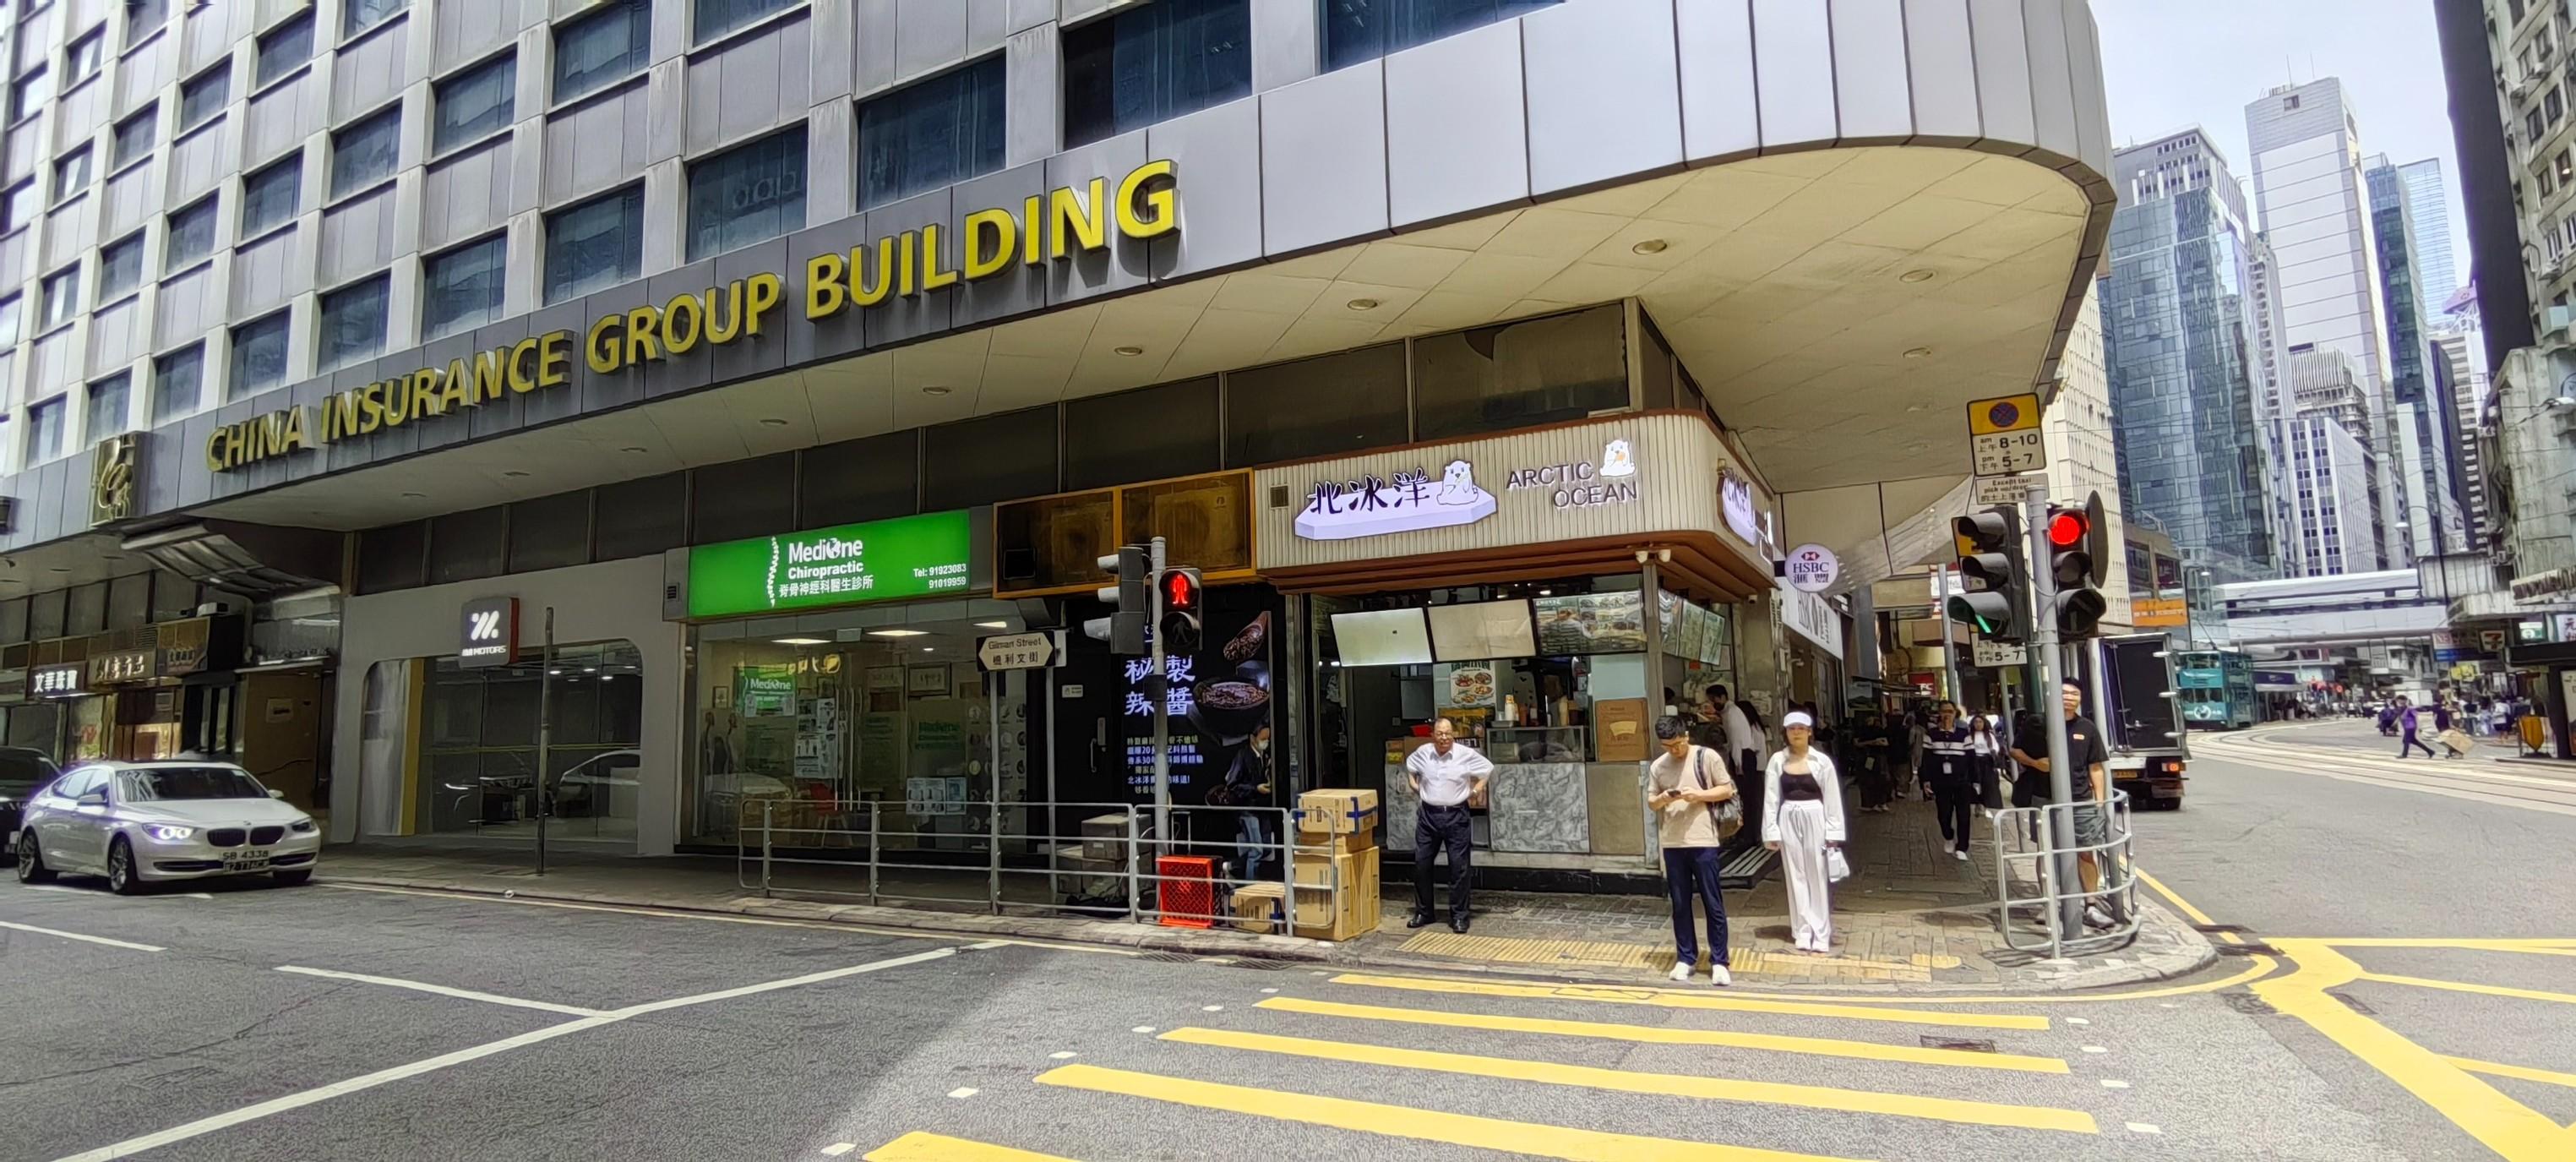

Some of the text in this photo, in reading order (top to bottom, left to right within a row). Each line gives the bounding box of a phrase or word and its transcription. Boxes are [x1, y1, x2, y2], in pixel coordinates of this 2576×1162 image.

[205, 159, 1179, 472] CHINA INSURANCE GROUP BUILDING
[1999, 434, 2038, 449] 8-10
[1506, 462, 1593, 490] ARCTIC
[1307, 466, 1430, 515] 北冰洋
[1553, 481, 1638, 508] OCEAN
[788, 560, 863, 580] Chiropractic
[912, 564, 967, 578] Tel: 91923083
[1793, 562, 1829, 574] HSBC
[473, 645, 507, 656] MOTORS
[1016, 637, 1042, 647] Street
